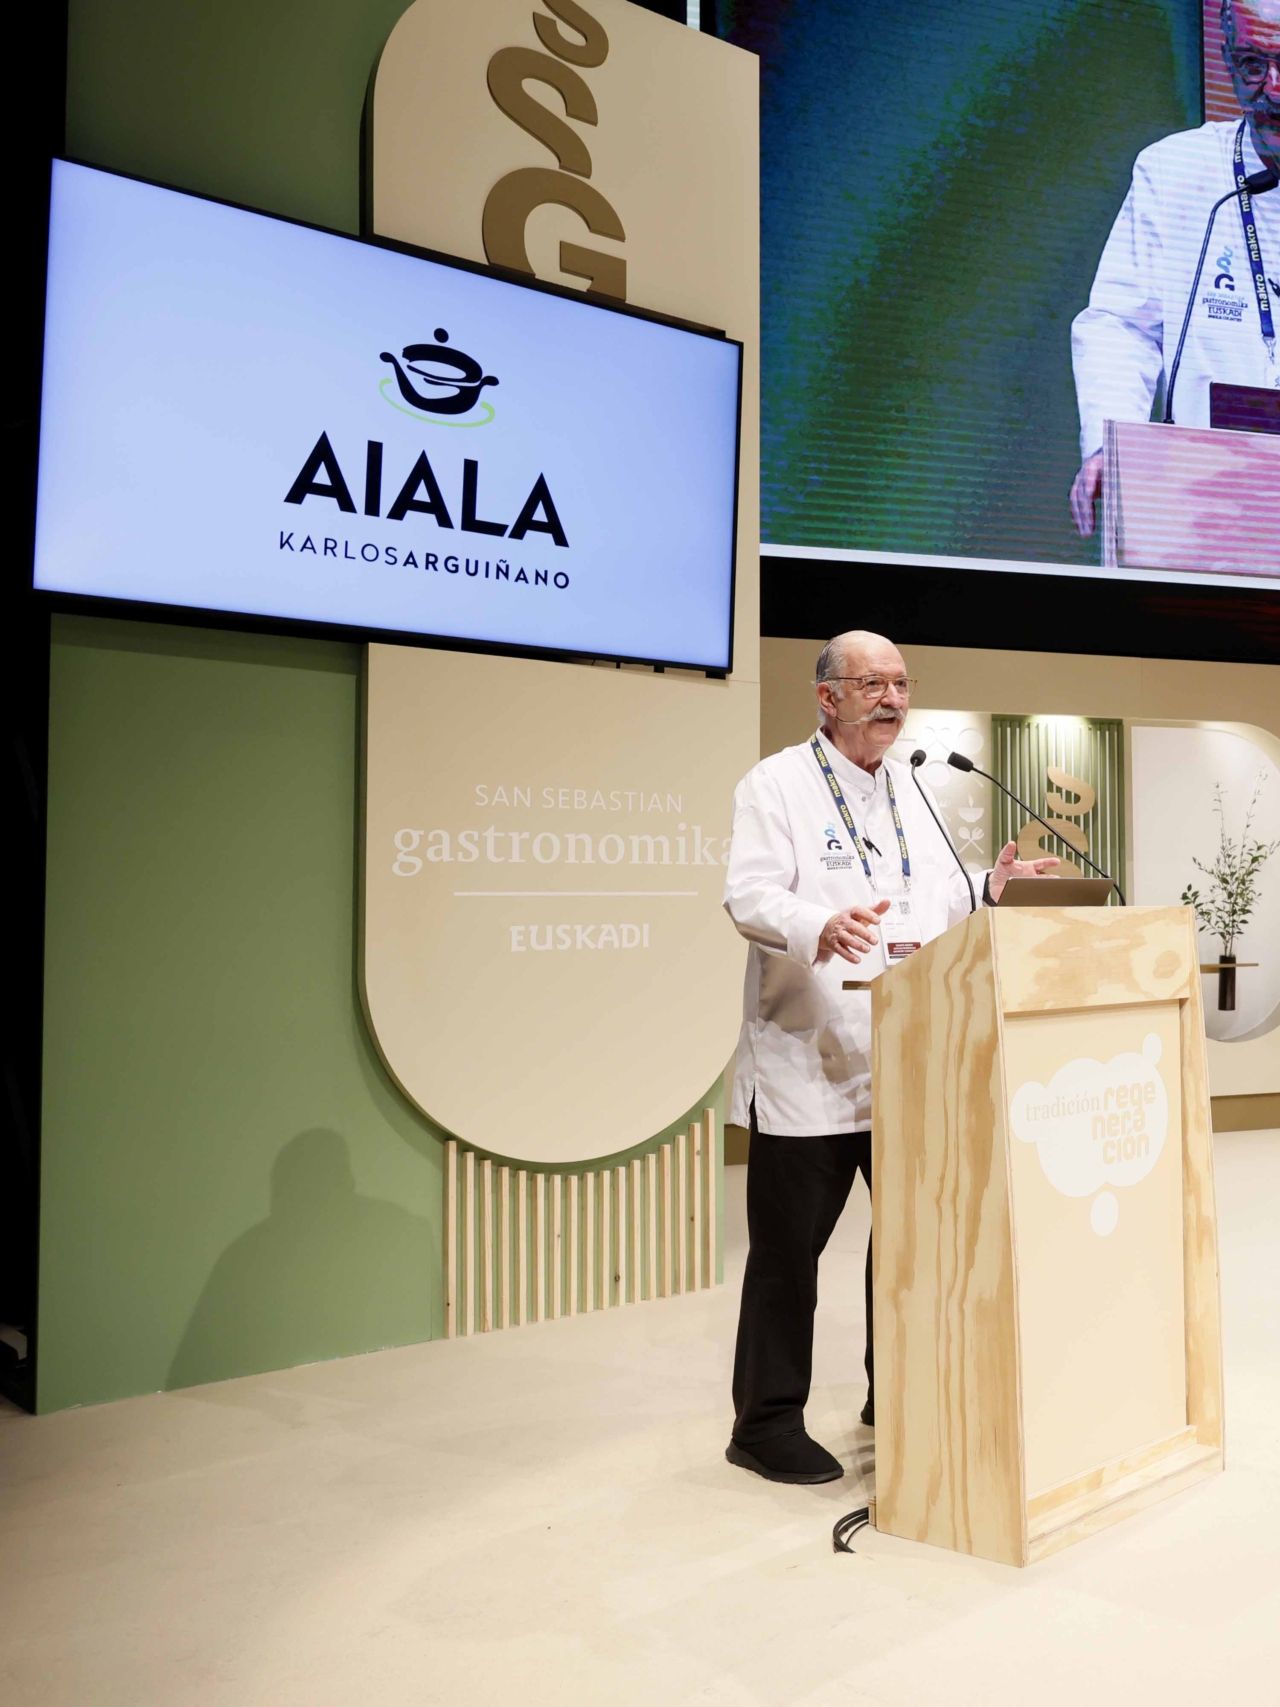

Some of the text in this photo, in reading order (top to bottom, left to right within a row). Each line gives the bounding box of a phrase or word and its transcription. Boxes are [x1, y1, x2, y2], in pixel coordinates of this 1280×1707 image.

[1237, 174, 1250, 212] maro
[1246, 224, 1260, 262] makro
[1255, 273, 1269, 312] makro
[283, 430, 570, 548] AIALA
[279, 531, 570, 589] KARLOSARGUIÑANO
[474, 784, 684, 814] SAN SEBASTIAN
[827, 773, 841, 798] makro
[840, 804, 854, 829] makro
[509, 923, 650, 952] EUSKADI
[1025, 1090, 1101, 1122] tradición
